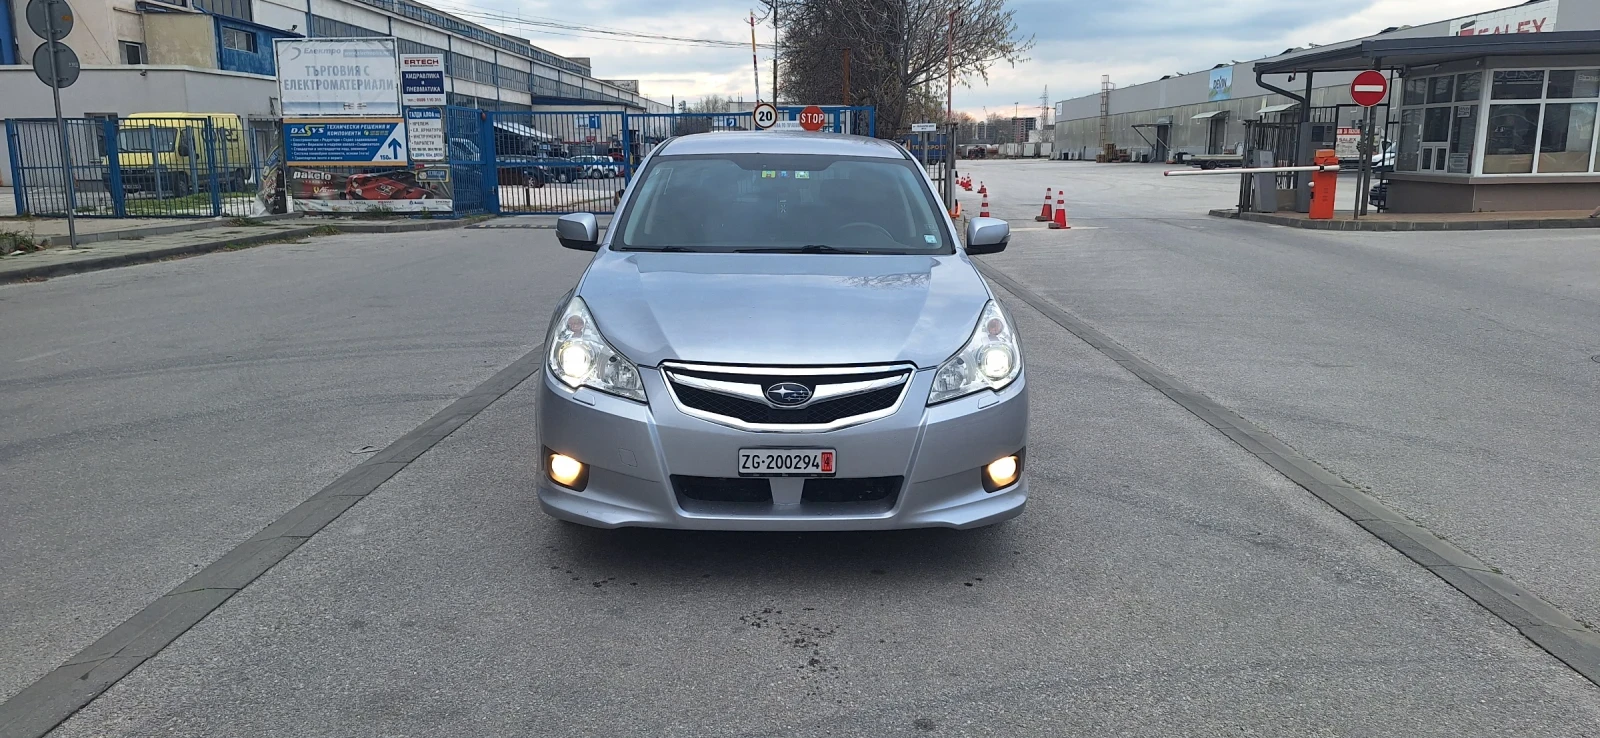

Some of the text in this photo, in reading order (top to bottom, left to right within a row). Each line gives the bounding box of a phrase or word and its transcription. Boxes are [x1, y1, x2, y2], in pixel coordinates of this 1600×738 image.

[305, 65, 370, 76] ТЪРГОВИЯ С
[284, 79, 394, 91] ЕЛЕКТРОМАТЕРИАЛИ
[758, 111, 773, 122] 20
[801, 112, 825, 125] STOP
[290, 125, 325, 136] DASYS
[293, 171, 331, 181] pakelo
